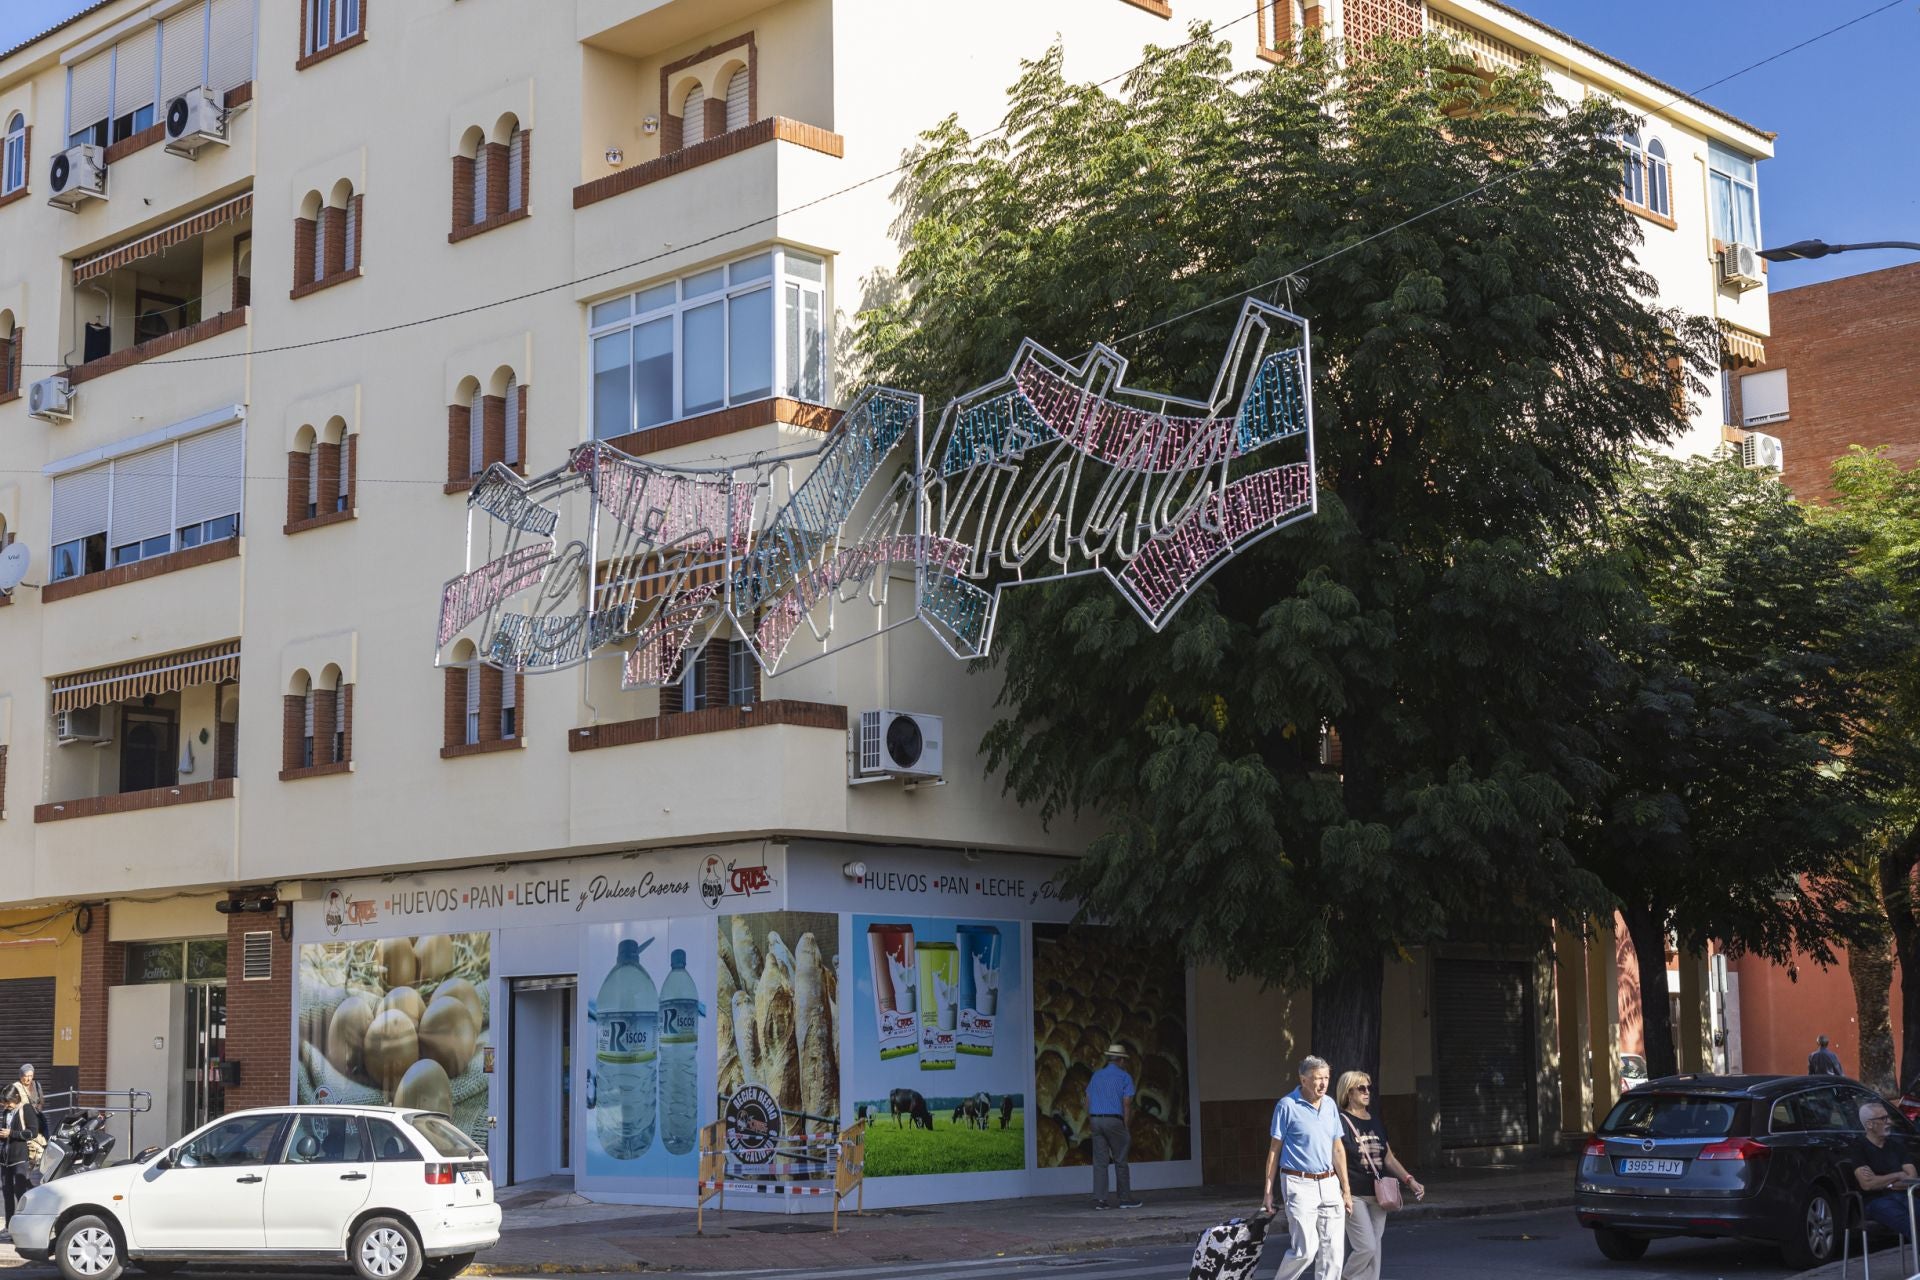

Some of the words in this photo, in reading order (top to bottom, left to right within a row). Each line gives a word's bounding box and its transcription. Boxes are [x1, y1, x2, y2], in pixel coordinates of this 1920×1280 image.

[391, 888, 458, 915] HUEVOS
[470, 884, 504, 909] PAN
[516, 879, 570, 906] LECHE
[575, 891, 588, 912] y
[588, 875, 638, 902] Dulces
[638, 871, 690, 898] Caseros
[730, 865, 770, 897] CRUCE
[864, 872, 927, 893] HUEVOS
[940, 876, 969, 894] PAN
[982, 878, 1025, 897] LECHE
[1030, 889, 1039, 905] y
[609, 1021, 647, 1052] Riscos
[663, 1008, 695, 1034] Riscos
[757, 1090, 778, 1121] HECHO
[1627, 1160, 1654, 1172] 3965
[1657, 1161, 1680, 1173] HJY
